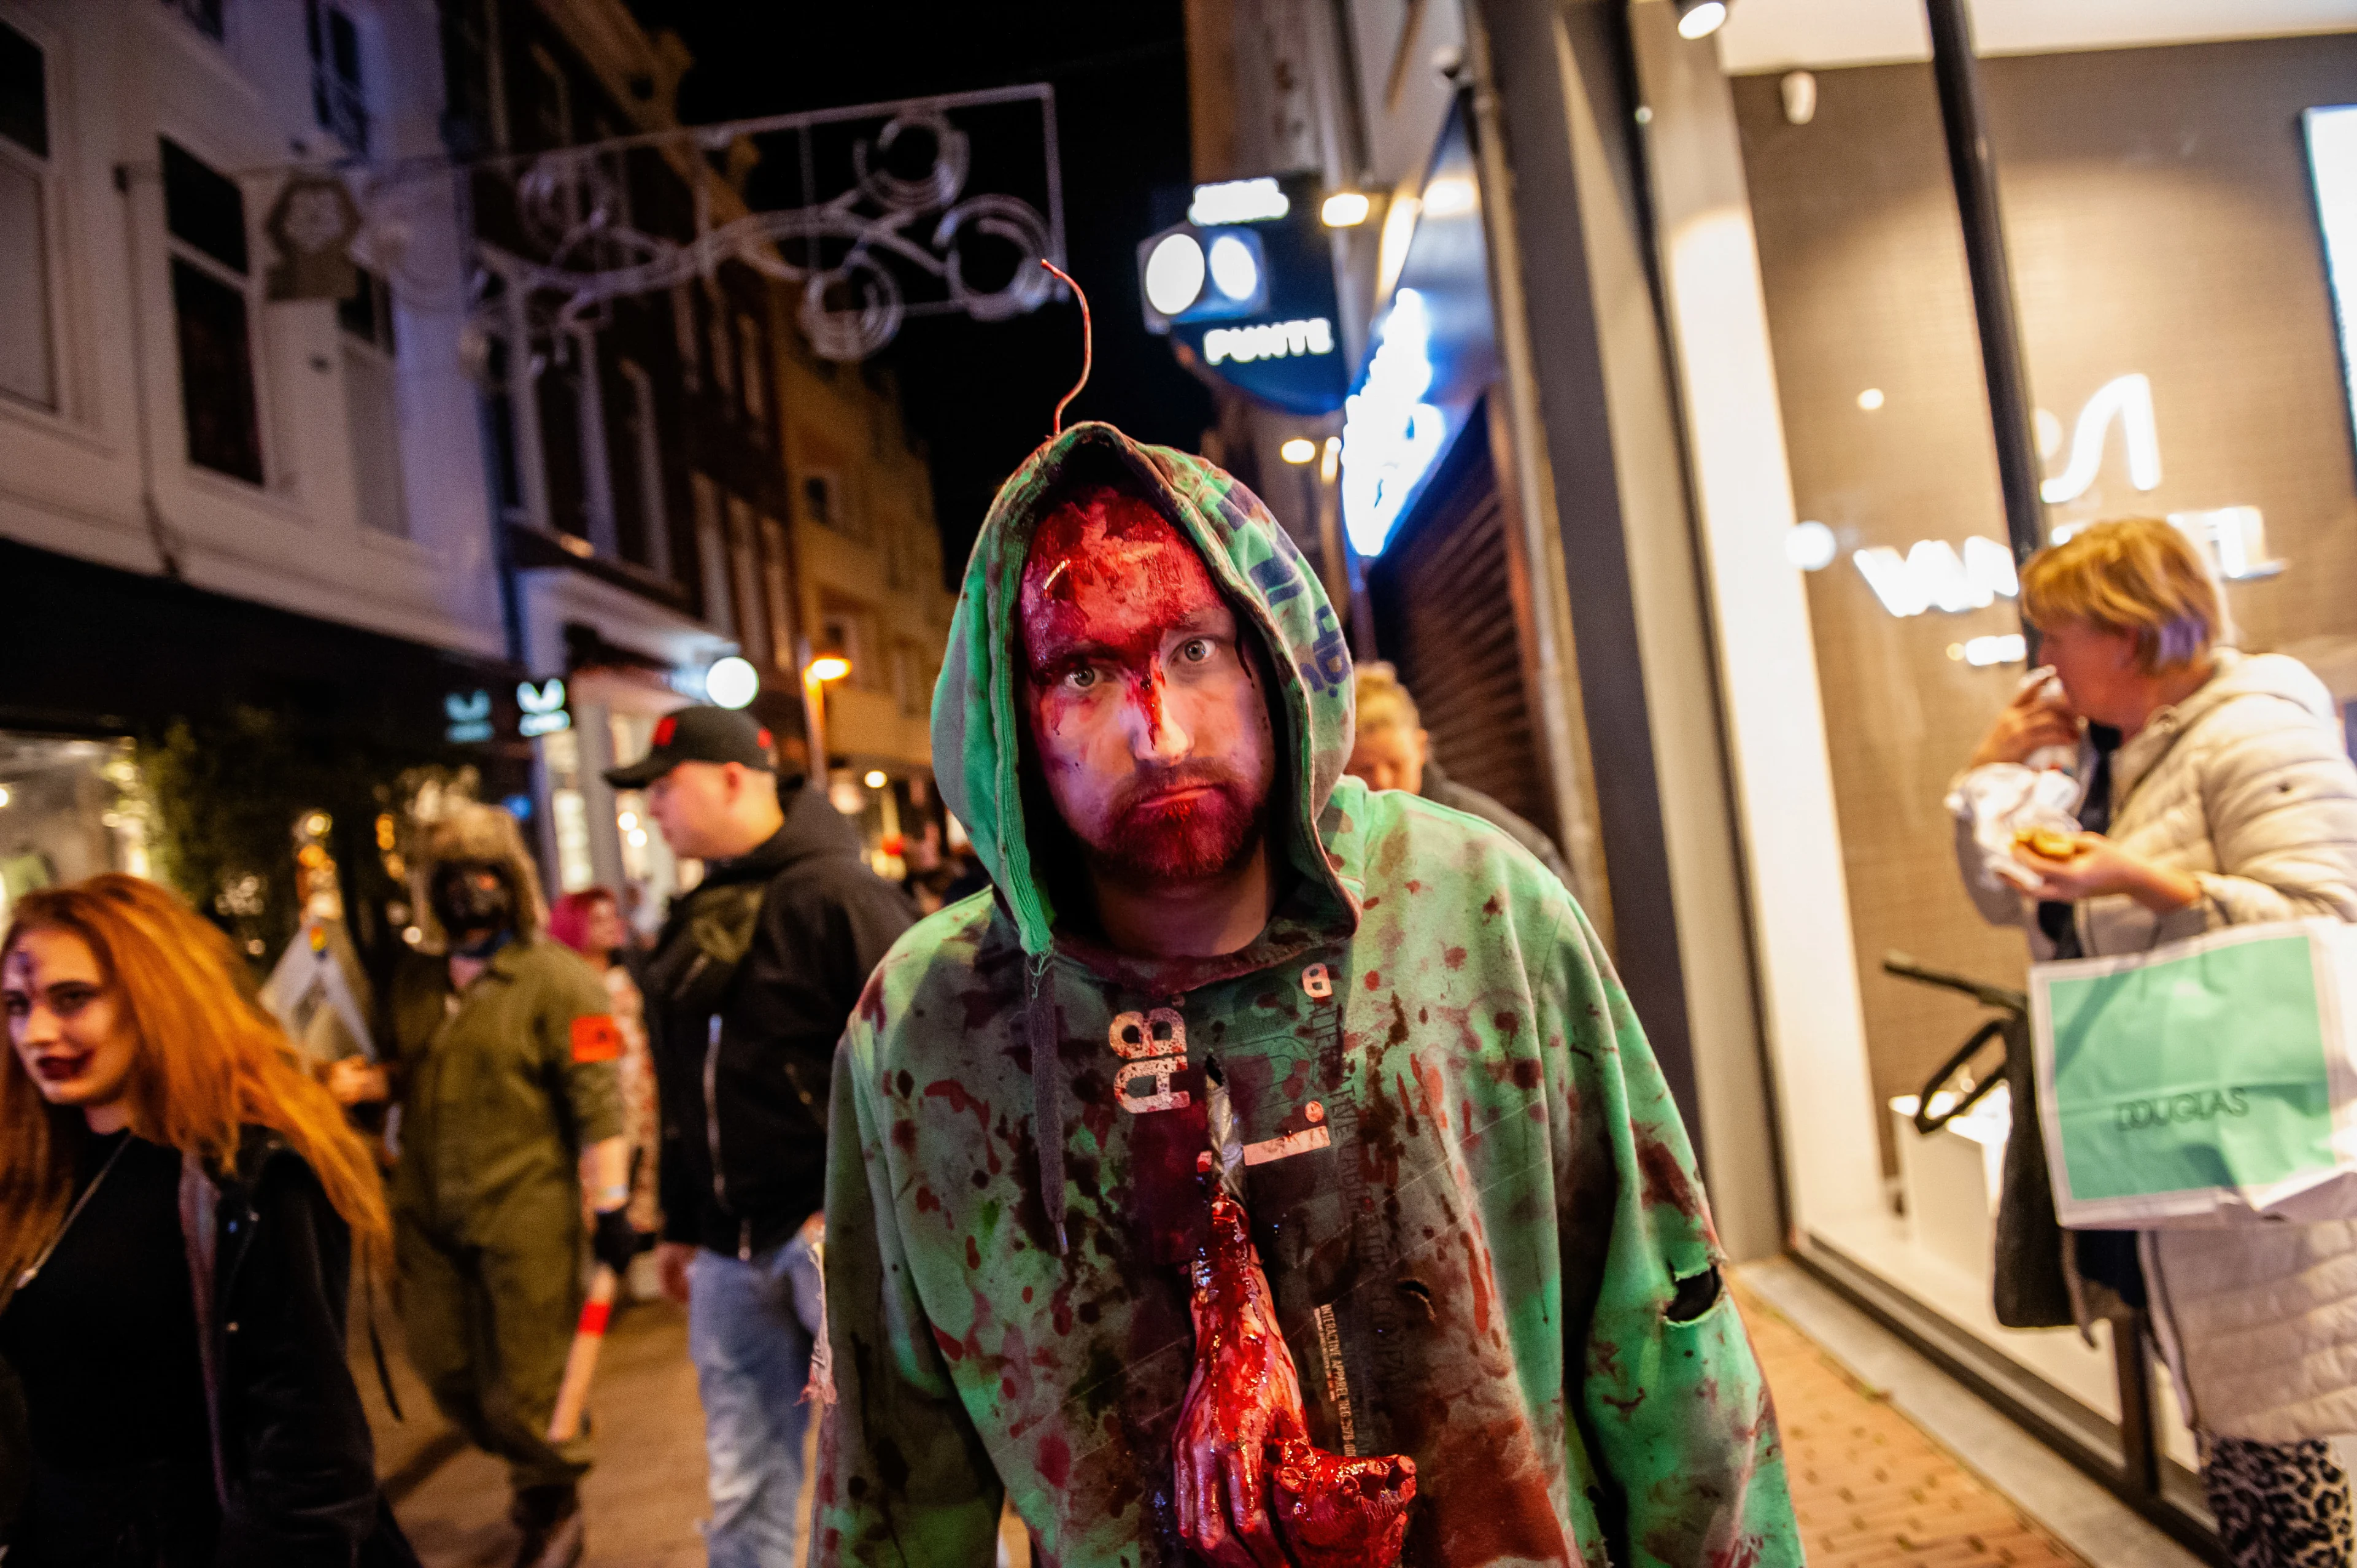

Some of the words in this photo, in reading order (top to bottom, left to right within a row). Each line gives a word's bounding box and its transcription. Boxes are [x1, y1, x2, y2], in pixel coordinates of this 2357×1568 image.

[2115, 1087, 2250, 1132] DOUGLAS
[1320, 1303, 1342, 1356] INTERACTIVE
[1331, 1359, 1349, 1399] APPAREL
